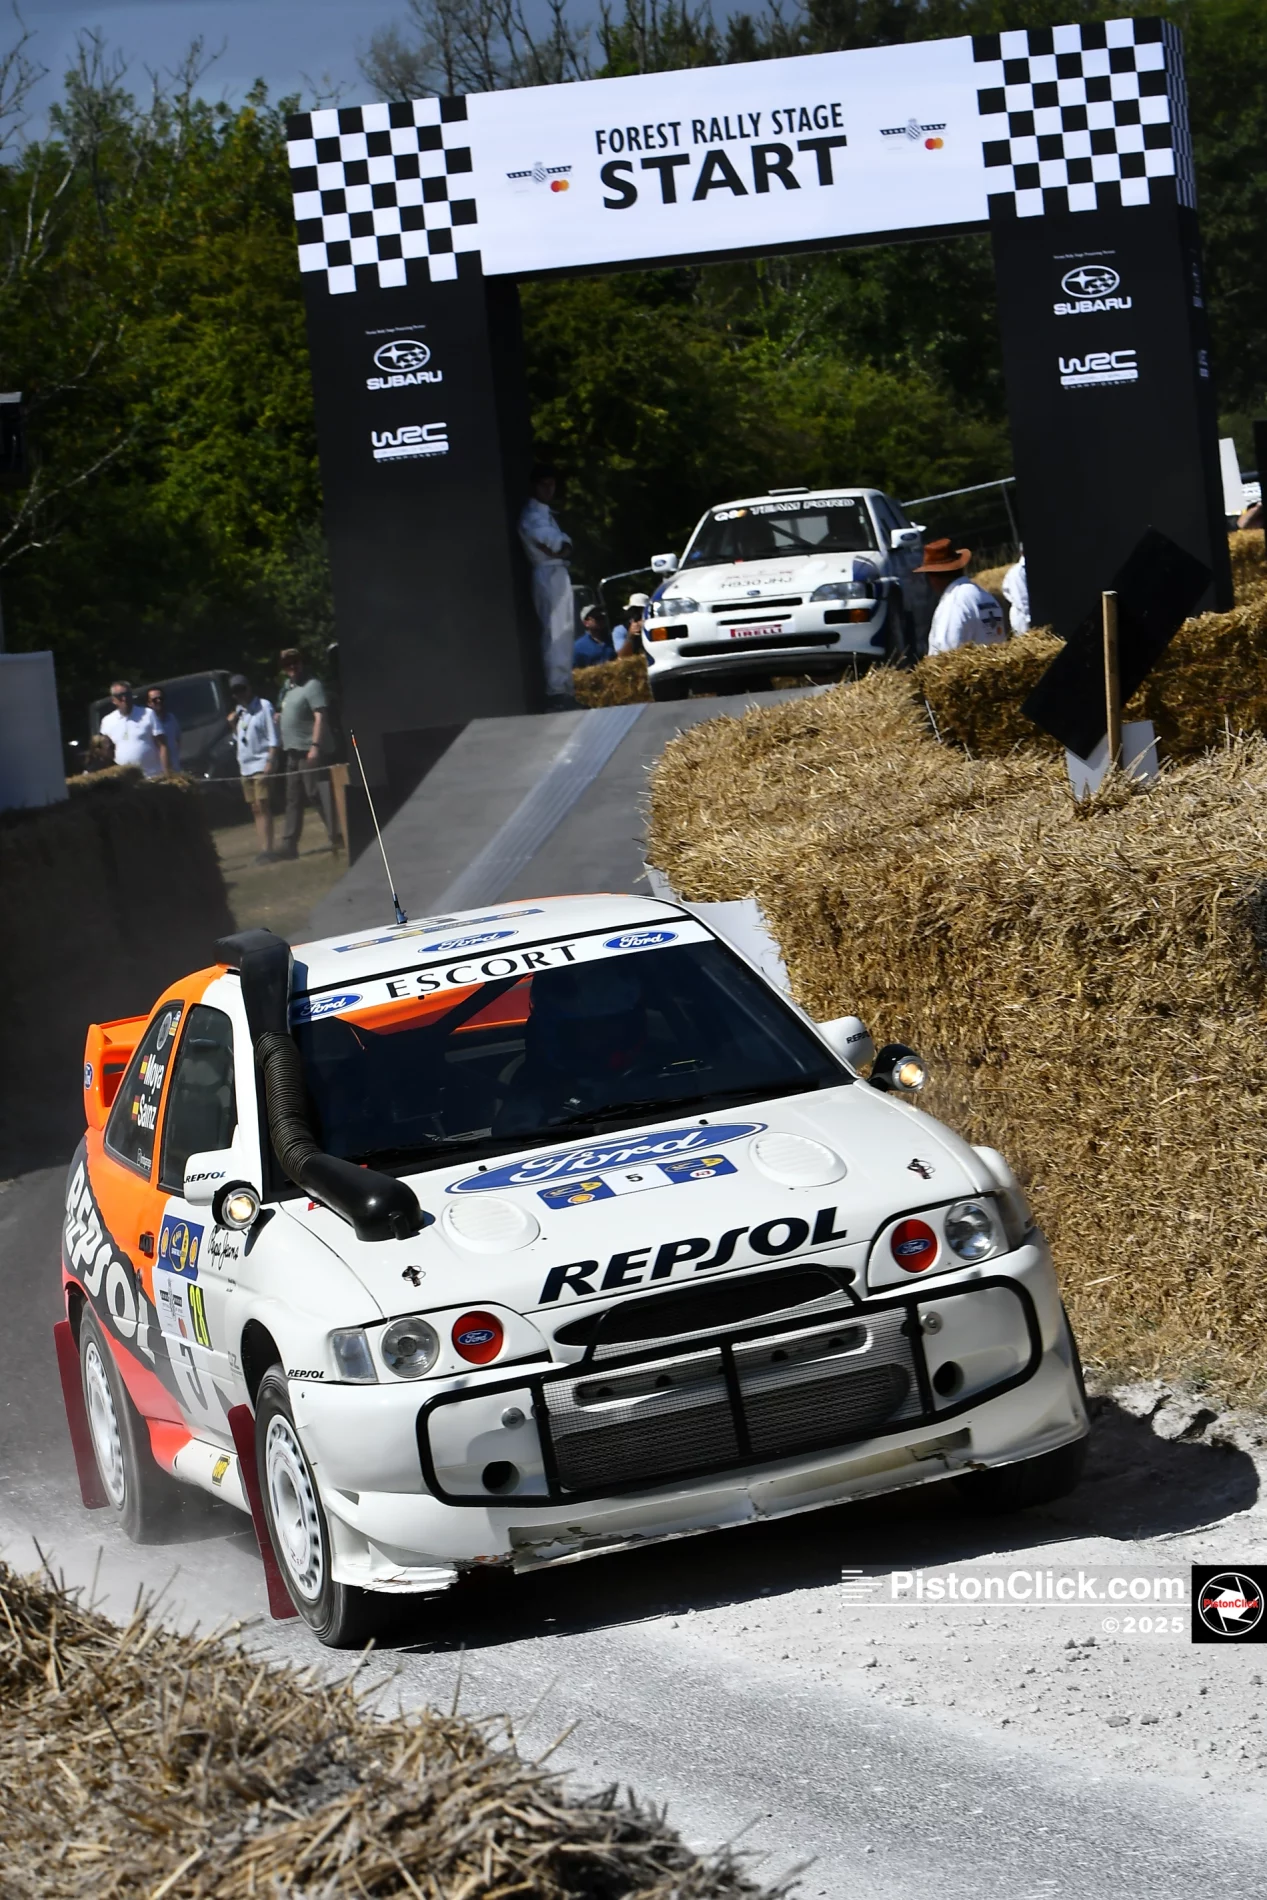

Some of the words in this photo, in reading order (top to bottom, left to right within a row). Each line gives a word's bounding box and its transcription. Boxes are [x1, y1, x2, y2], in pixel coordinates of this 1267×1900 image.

[595, 122, 681, 155] FOREST
[691, 113, 761, 145] RALLY
[771, 102, 844, 135] STAGE
[600, 134, 848, 210] START
[1053, 296, 1132, 316] SUBARU
[1058, 350, 1138, 374] WRC
[366, 370, 443, 391] SUBARU
[371, 422, 448, 448] WRC
[749, 501, 801, 515] TEAM
[803, 498, 855, 509] FORD
[730, 624, 783, 638] PIRELLI
[437, 932, 502, 951] Ford
[619, 933, 664, 947] Ford
[386, 943, 577, 999] ESCORT
[301, 997, 346, 1016] Ford
[143, 1053, 165, 1095] Moya
[137, 1093, 158, 1130] Sainz
[509, 1131, 707, 1183] Ford
[185, 1171, 226, 1183] REPSOL
[625, 1173, 644, 1183] 5
[65, 1160, 156, 1365] REPSOL
[538, 1206, 847, 1304] REPSOL
[189, 1284, 210, 1348] 28
[287, 1369, 325, 1378] REPSOL
